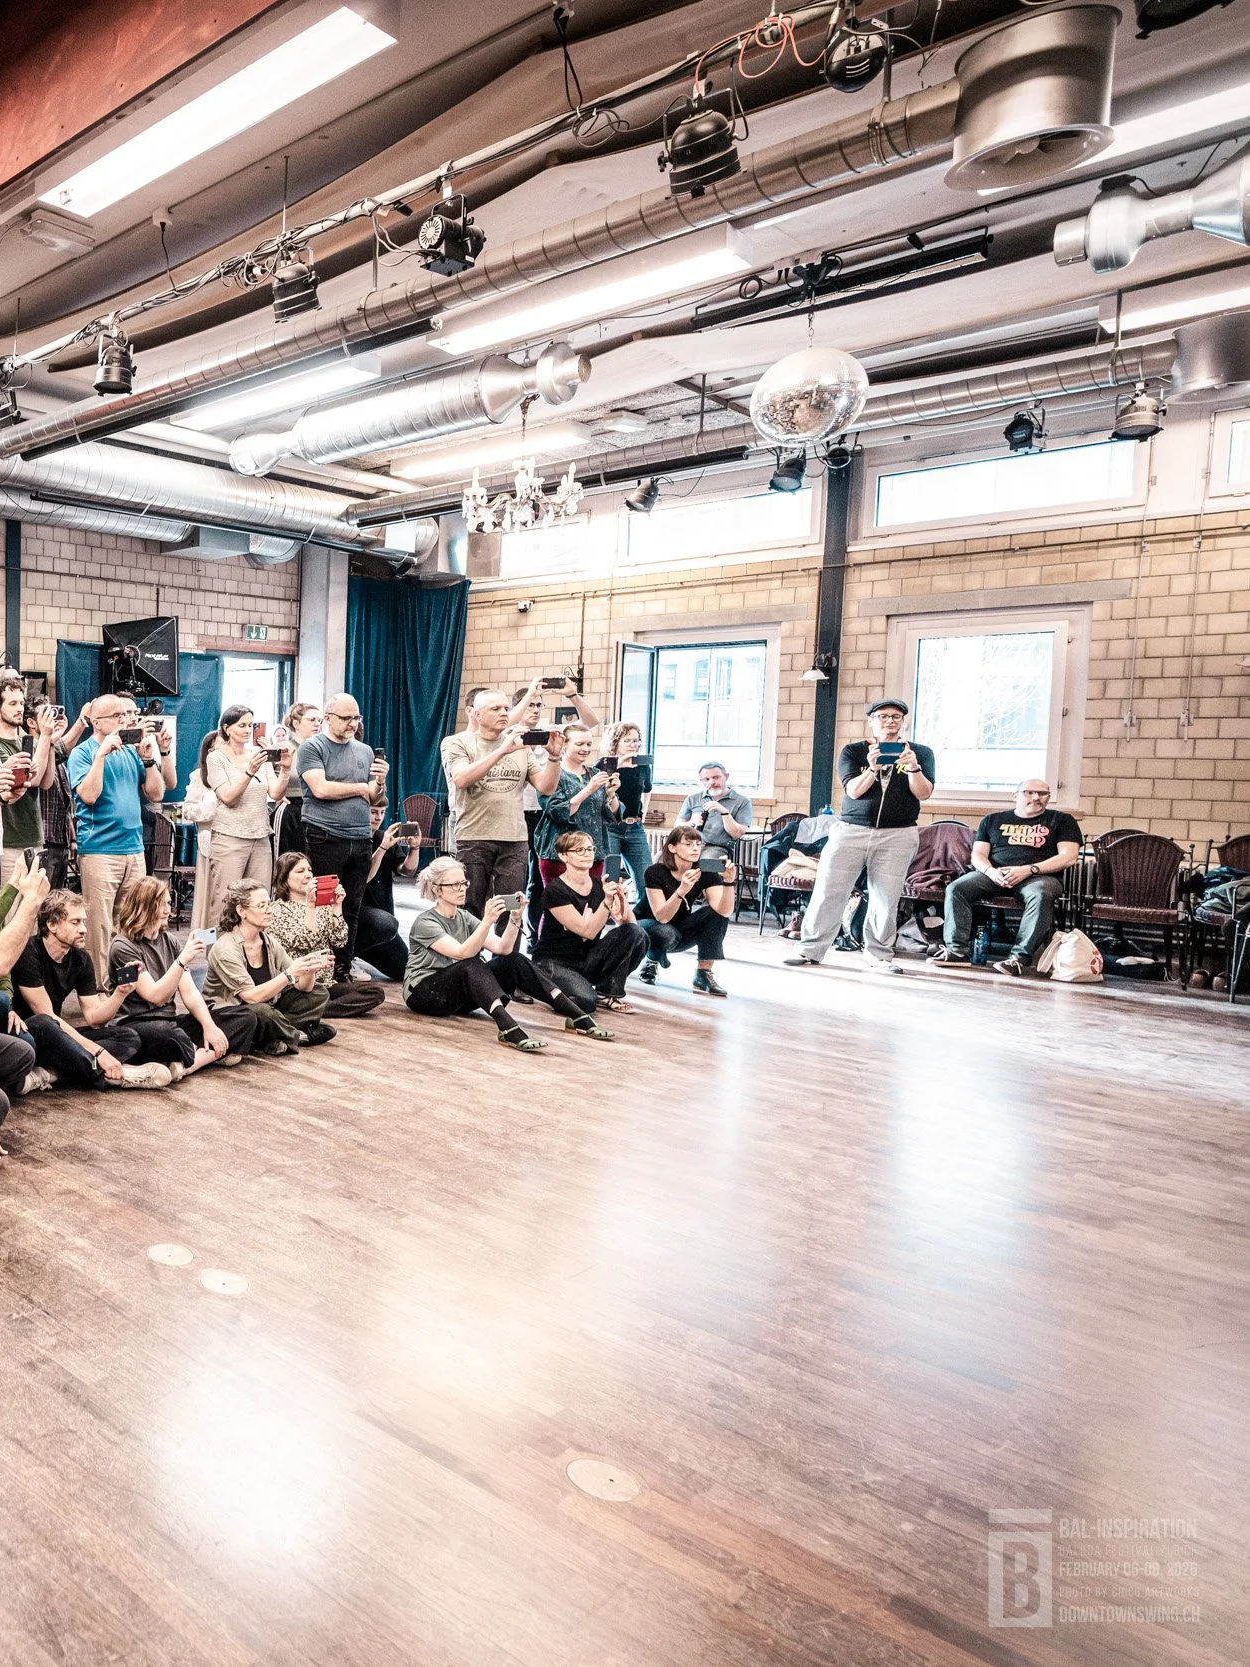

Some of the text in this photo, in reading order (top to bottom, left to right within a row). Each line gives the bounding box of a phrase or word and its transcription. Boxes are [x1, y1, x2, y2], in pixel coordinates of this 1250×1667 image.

[486, 766, 521, 778] uisiana
[1001, 824, 1049, 836] Triple
[1009, 835, 1046, 848] step
